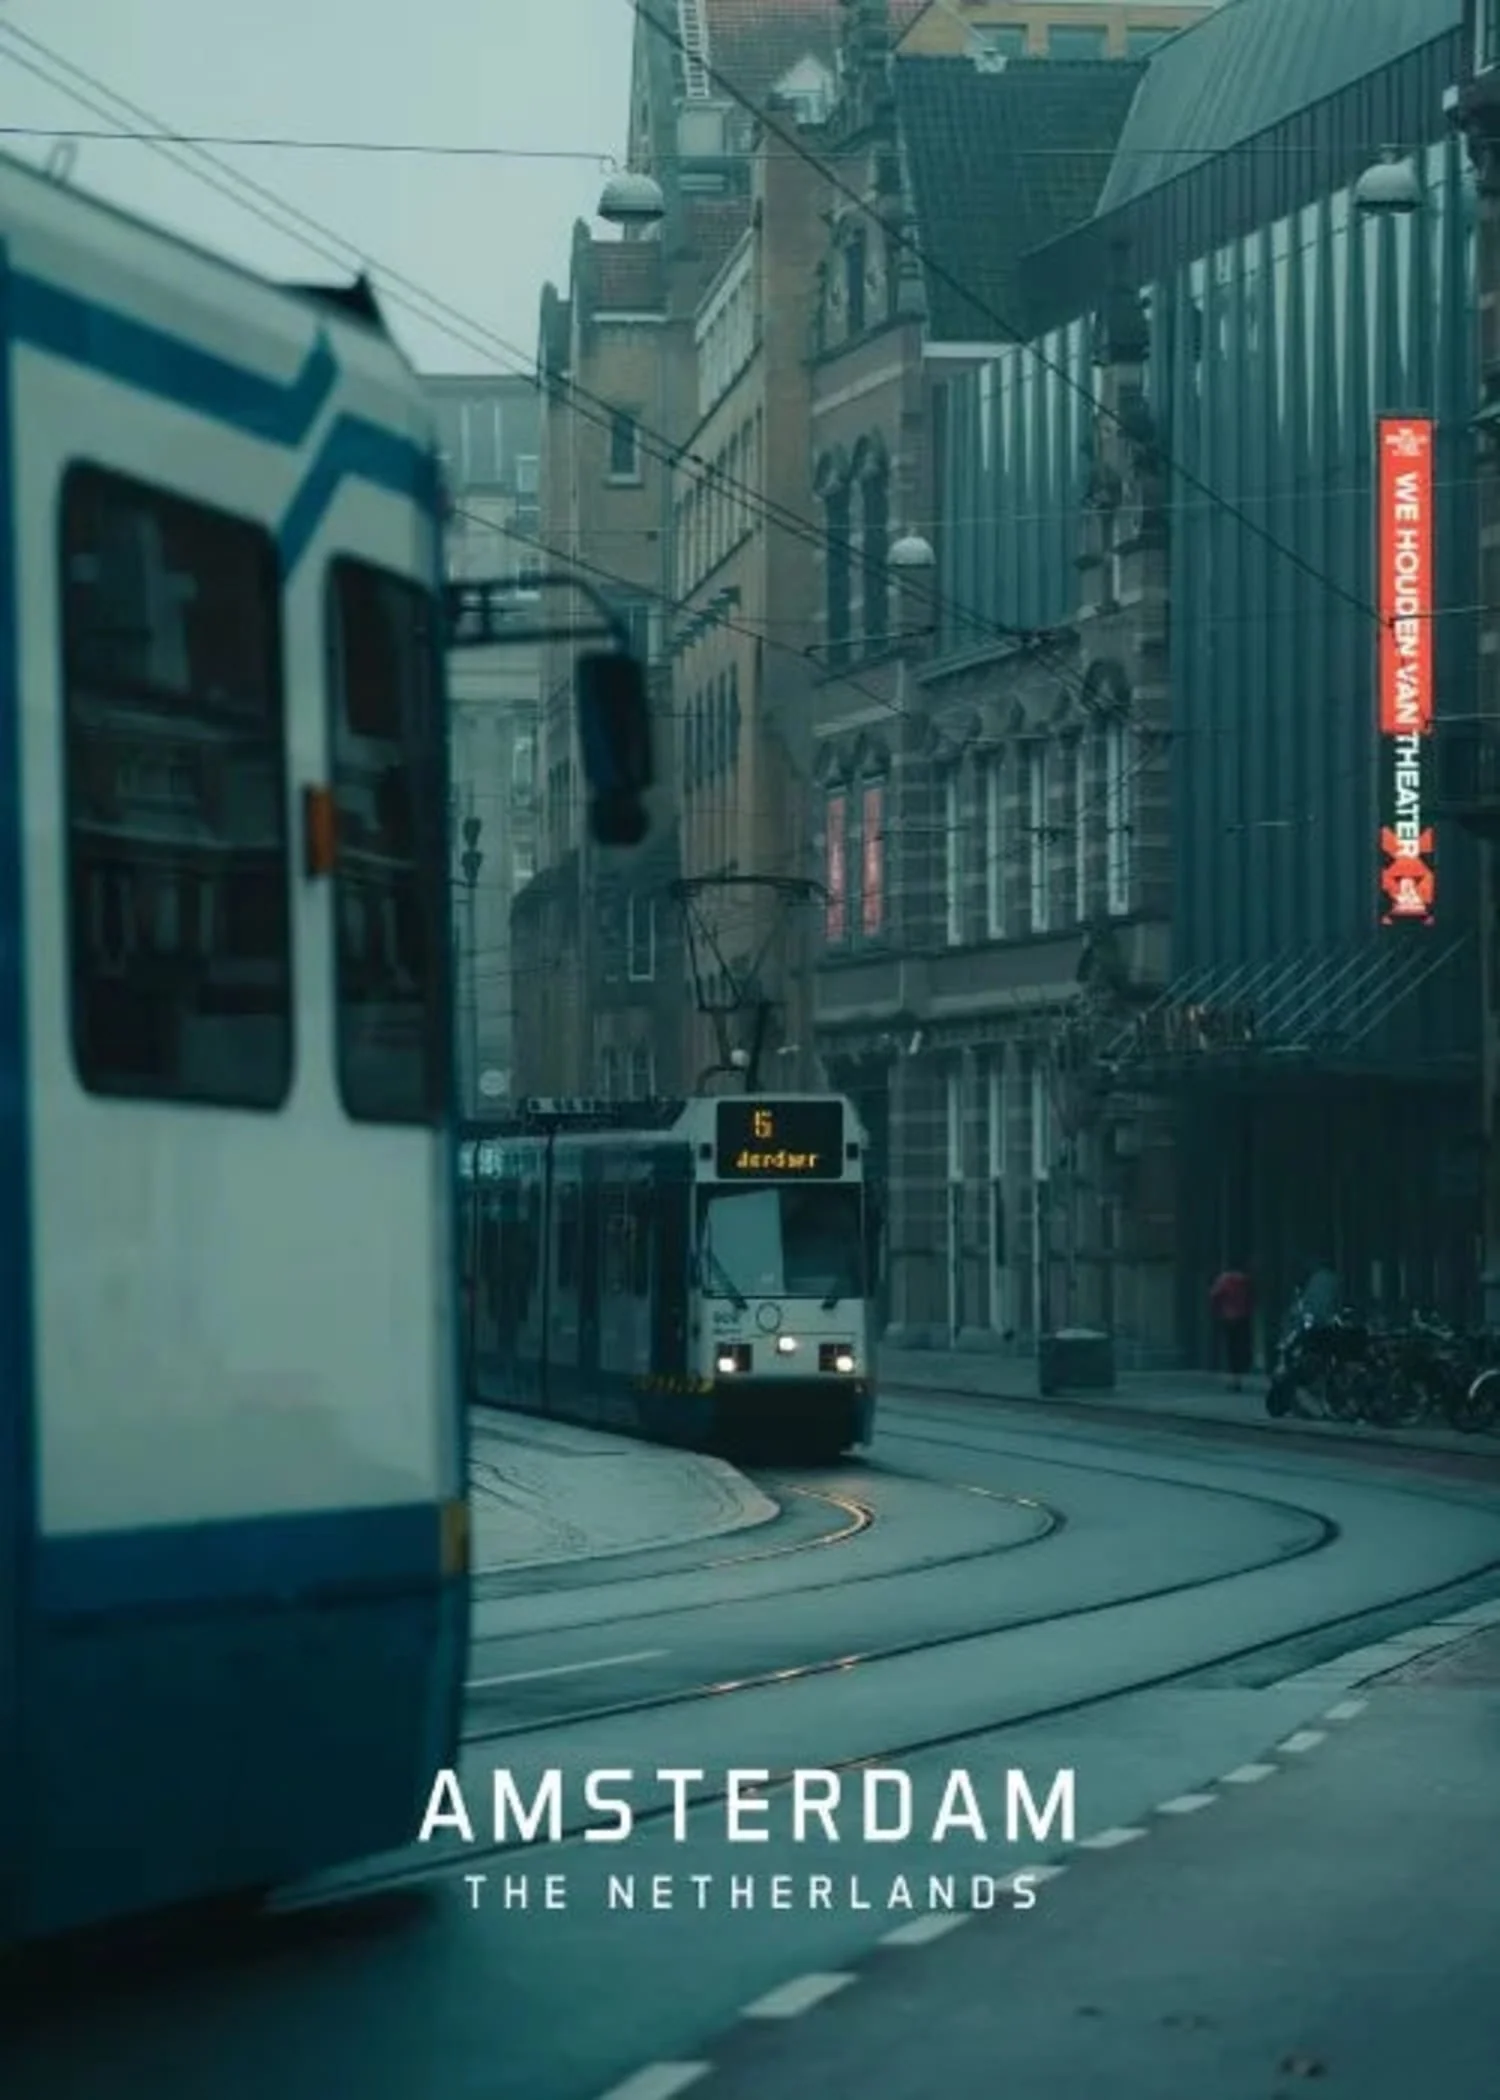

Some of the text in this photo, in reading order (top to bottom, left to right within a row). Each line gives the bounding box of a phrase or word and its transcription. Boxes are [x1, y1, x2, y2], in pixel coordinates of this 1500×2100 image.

[1394, 472, 1420, 859] WE HOUDEN VAN THEATER
